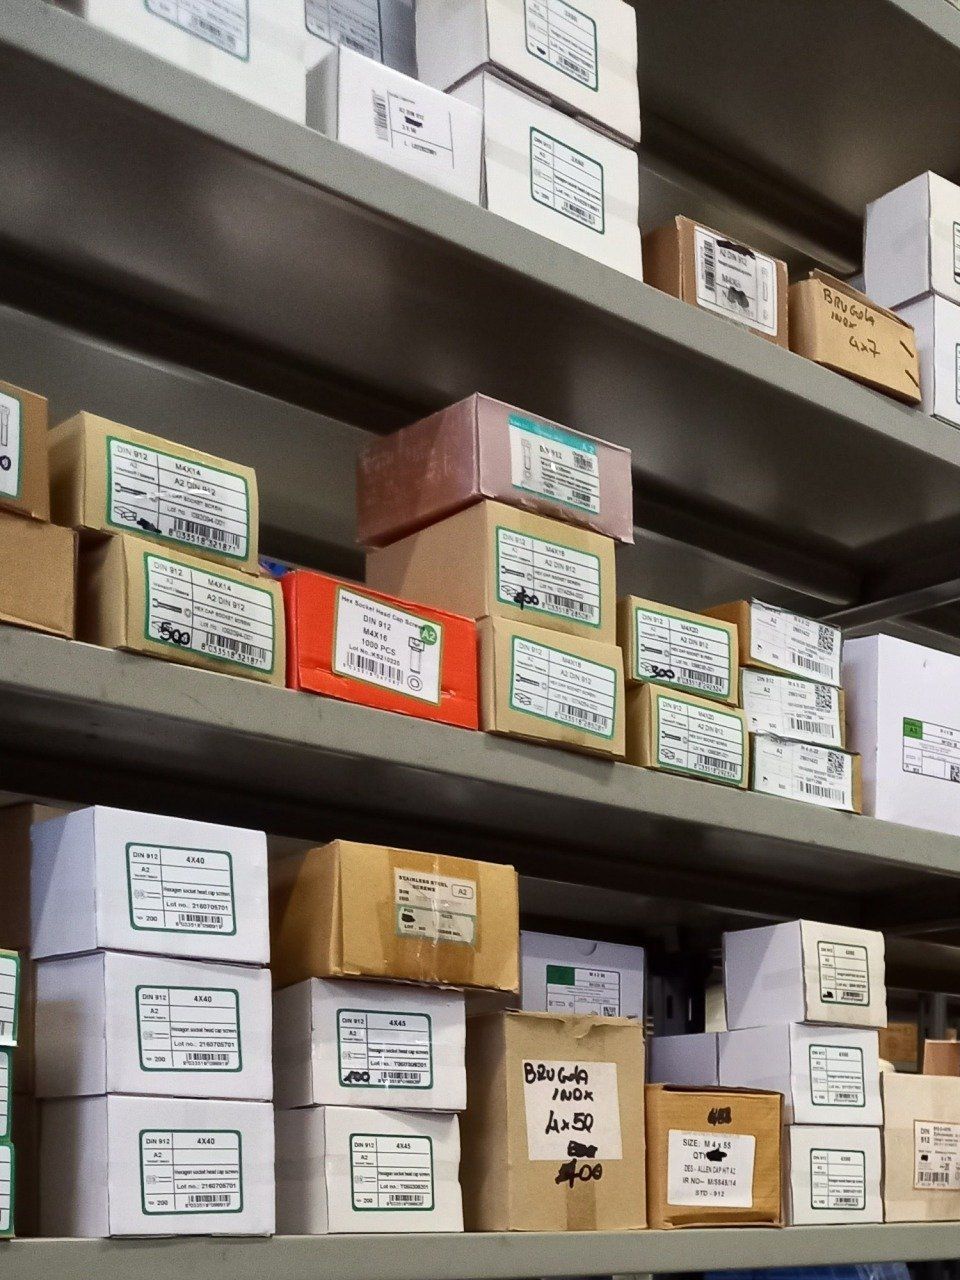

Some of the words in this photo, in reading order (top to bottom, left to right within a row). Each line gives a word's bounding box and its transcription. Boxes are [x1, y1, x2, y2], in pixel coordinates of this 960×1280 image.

[117, 445, 131, 455] DIN
[134, 451, 148, 461] 912
[174, 478, 185, 486] A2
[169, 528, 172, 536] 8
[154, 562, 167, 572] DIN
[170, 567, 182, 576] 912
[206, 594, 217, 602] A2
[218, 597, 232, 607] DIN
[233, 602, 245, 611] 912
[342, 595, 352, 605] Hex
[355, 600, 374, 612] Socket
[376, 608, 390, 618] Head
[393, 614, 403, 623] Cap
[363, 615, 376, 625] DIN
[378, 621, 391, 631] 912
[642, 613, 650, 621] DIN
[363, 628, 387, 642] M4X16
[422, 629, 436, 642] A2
[362, 639, 378, 650] 1000
[380, 645, 396, 656] PCS
[519, 643, 530, 651] DIN
[532, 647, 542, 655] 912
[570, 673, 580, 681] DIN
[581, 676, 591, 684] 912
[186, 856, 205, 864] 4X40
[399, 875, 429, 884] STAINLESS
[412, 884, 436, 892] SCREWS
[552, 1087, 594, 1101] INOX
